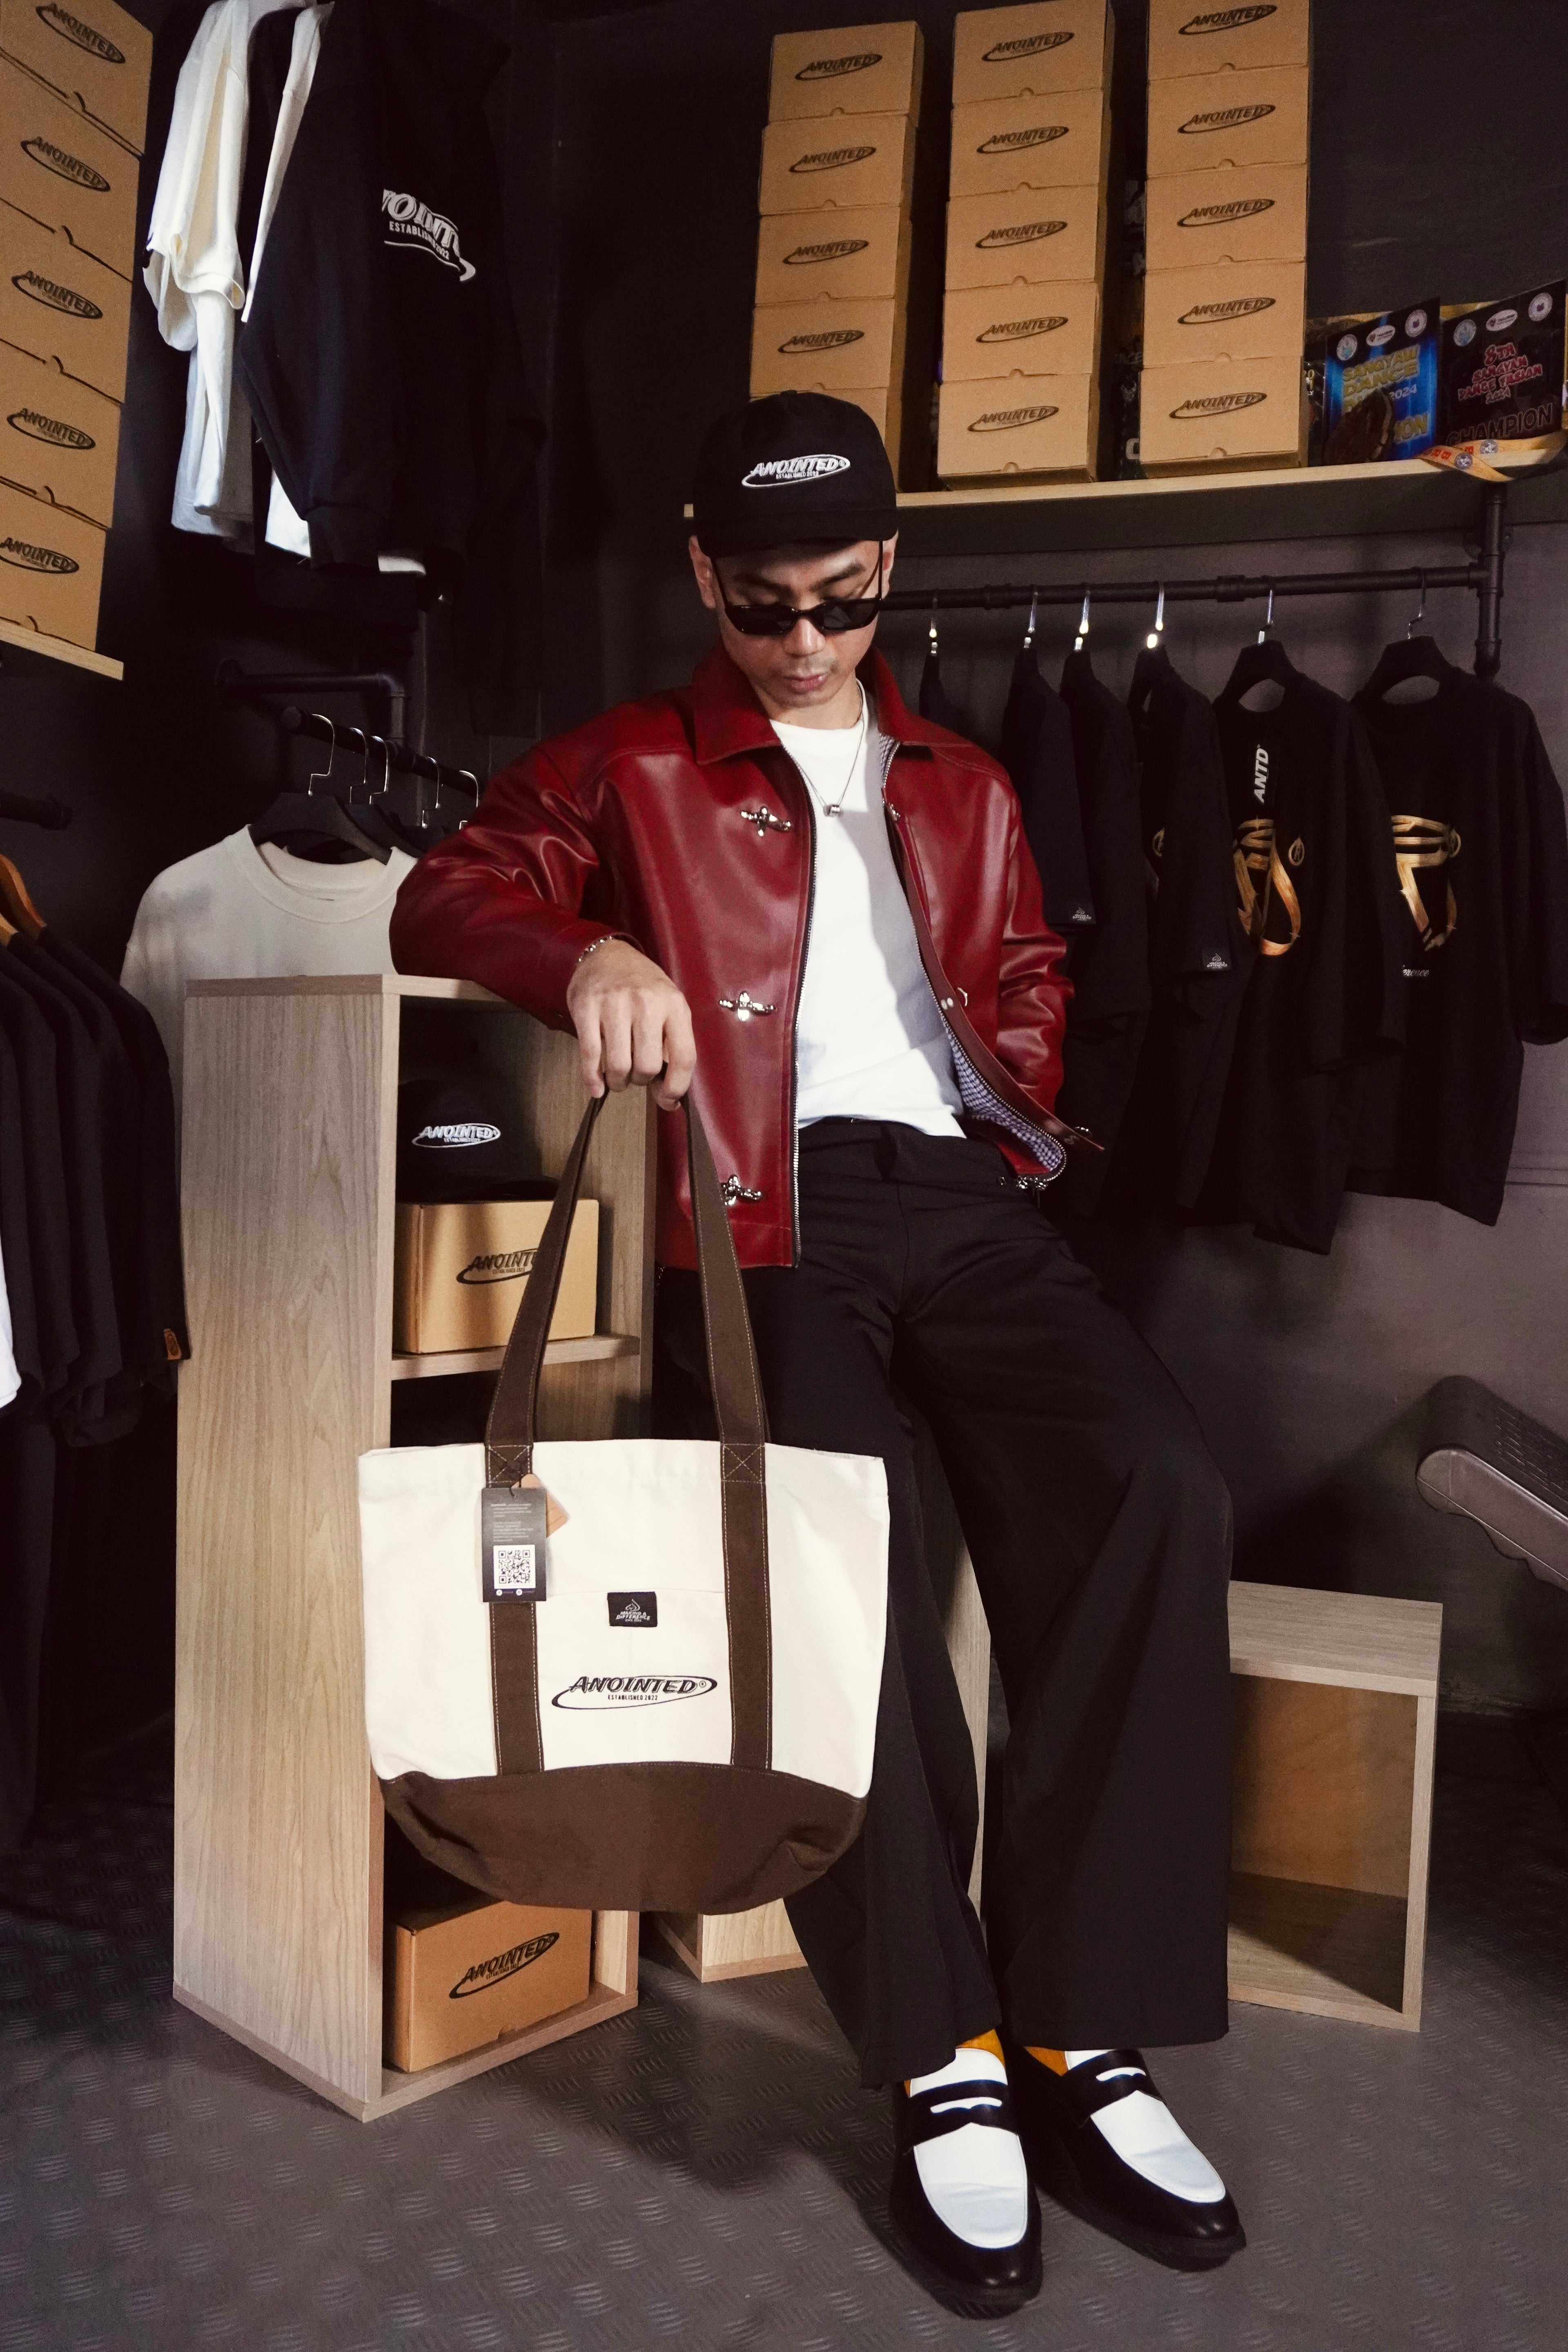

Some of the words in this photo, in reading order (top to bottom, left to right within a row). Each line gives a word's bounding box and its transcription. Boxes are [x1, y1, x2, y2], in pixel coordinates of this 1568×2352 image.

[1190, 7, 1265, 26] ANOINTED
[47, 3, 118, 61] ANOINTED
[993, 33, 1063, 53] ANOINTED
[806, 56, 871, 72] ANOINTED
[1188, 107, 1263, 124] ANOINTED
[987, 128, 1058, 145] ANOINTED
[33, 136, 101, 187] ANOINTED
[800, 149, 866, 163] ANOINTED
[1189, 200, 1263, 218] ANOINTED
[986, 223, 1056, 240] ANOINTED
[793, 243, 858, 256] ANOINTED
[23, 270, 93, 315] ANOINTED
[1188, 298, 1263, 316] ANOINTED
[987, 319, 1057, 334] ANOINTED
[789, 332, 853, 345] ANOINTED
[1181, 394, 1254, 410] ANOINTED
[979, 408, 1047, 423] ANOINTED
[1446, 403, 1552, 444] CHAMPION
[18, 408, 86, 445] ANOINTED
[750, 458, 839, 477] ANOINTED
[1, 537, 71, 570] ANOINTED
[1254, 748, 1268, 804] ANTD
[419, 1125, 493, 1139] ANOINTED
[468, 1252, 536, 1272] ANOINT
[569, 1676, 697, 1694] ANOINTED
[462, 1938, 547, 1982] ANOINTED
